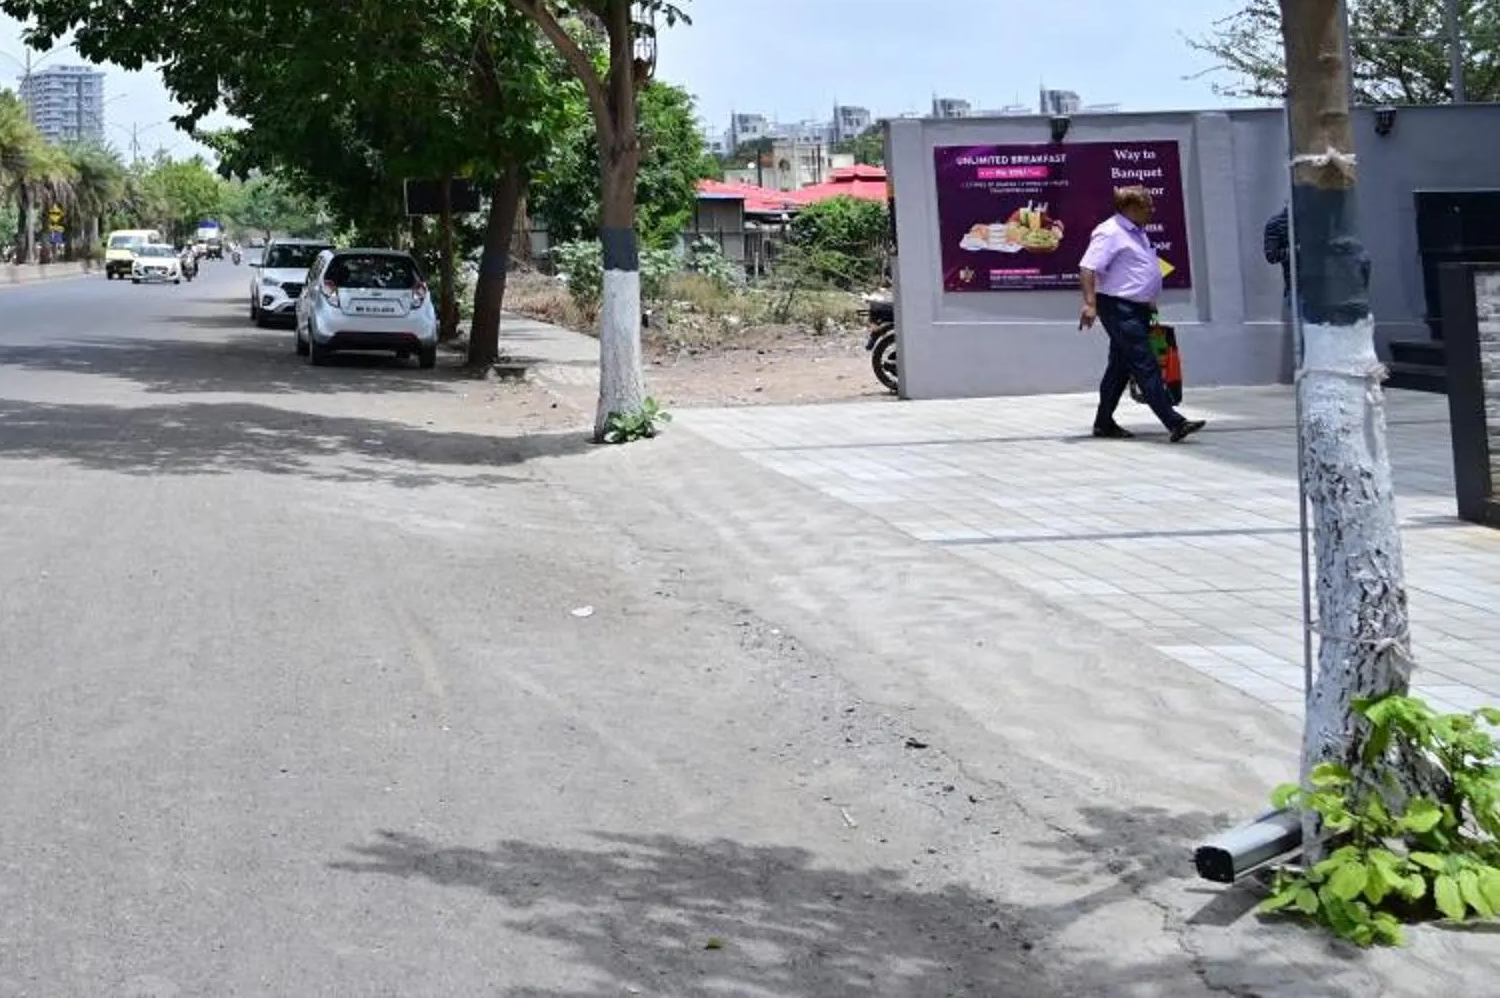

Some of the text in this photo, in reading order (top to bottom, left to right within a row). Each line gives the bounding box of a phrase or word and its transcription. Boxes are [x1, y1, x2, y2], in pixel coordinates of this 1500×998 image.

[955, 154, 1067, 165] UNLIMITED BREAKFAST
[1113, 149, 1156, 163] Way to
[1111, 167, 1163, 181] Banquet
